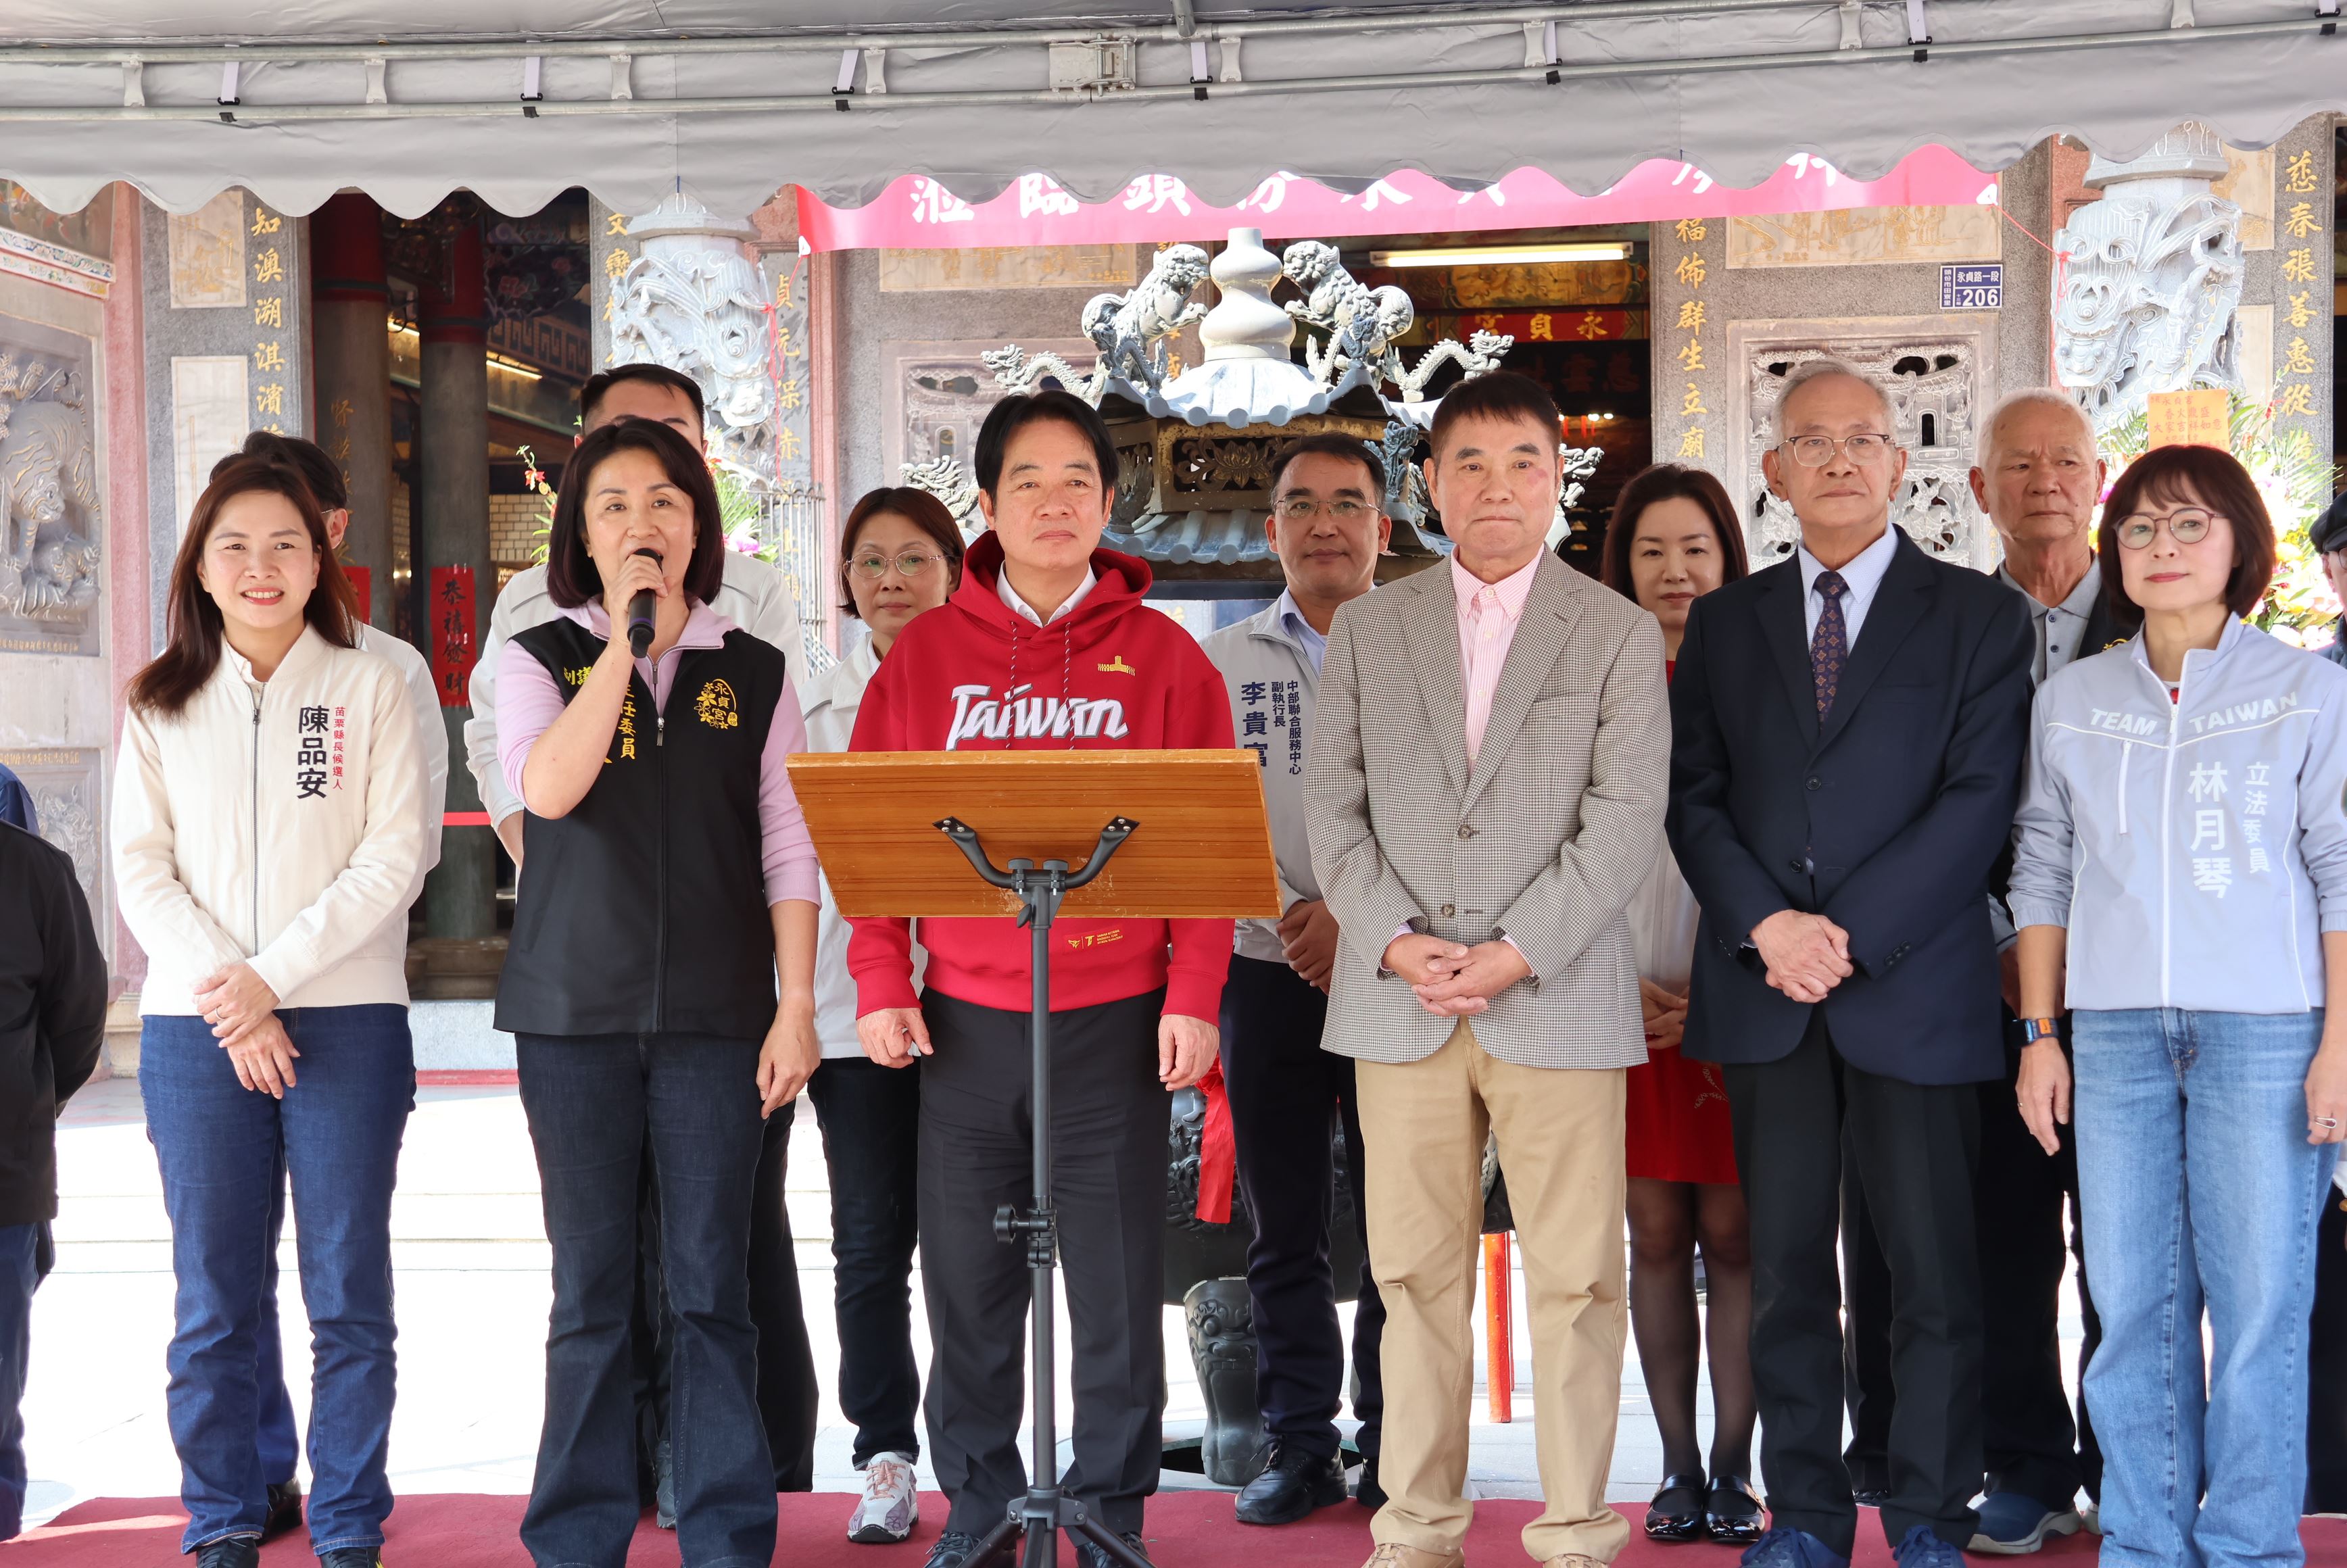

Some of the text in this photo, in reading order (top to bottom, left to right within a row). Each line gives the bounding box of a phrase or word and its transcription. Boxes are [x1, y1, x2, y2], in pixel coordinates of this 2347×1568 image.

[1957, 271, 2000, 283] 永貞路一段
[1962, 289, 1998, 306] 206
[251, 207, 285, 437] 知澳溯淇濱
[441, 578, 468, 695] 恭禧發財
[332, 706, 346, 790] 苗栗縣長候選人
[946, 683, 1130, 752] Taiwan
[1272, 681, 1286, 727] 副執行長
[1287, 680, 1302, 775] 中部聯合服務中心
[2090, 691, 2298, 737] TEAM TAIWAN
[296, 705, 330, 799] 陳品安
[2187, 761, 2233, 899] 林月琴
[2242, 761, 2272, 874] 立法委員
